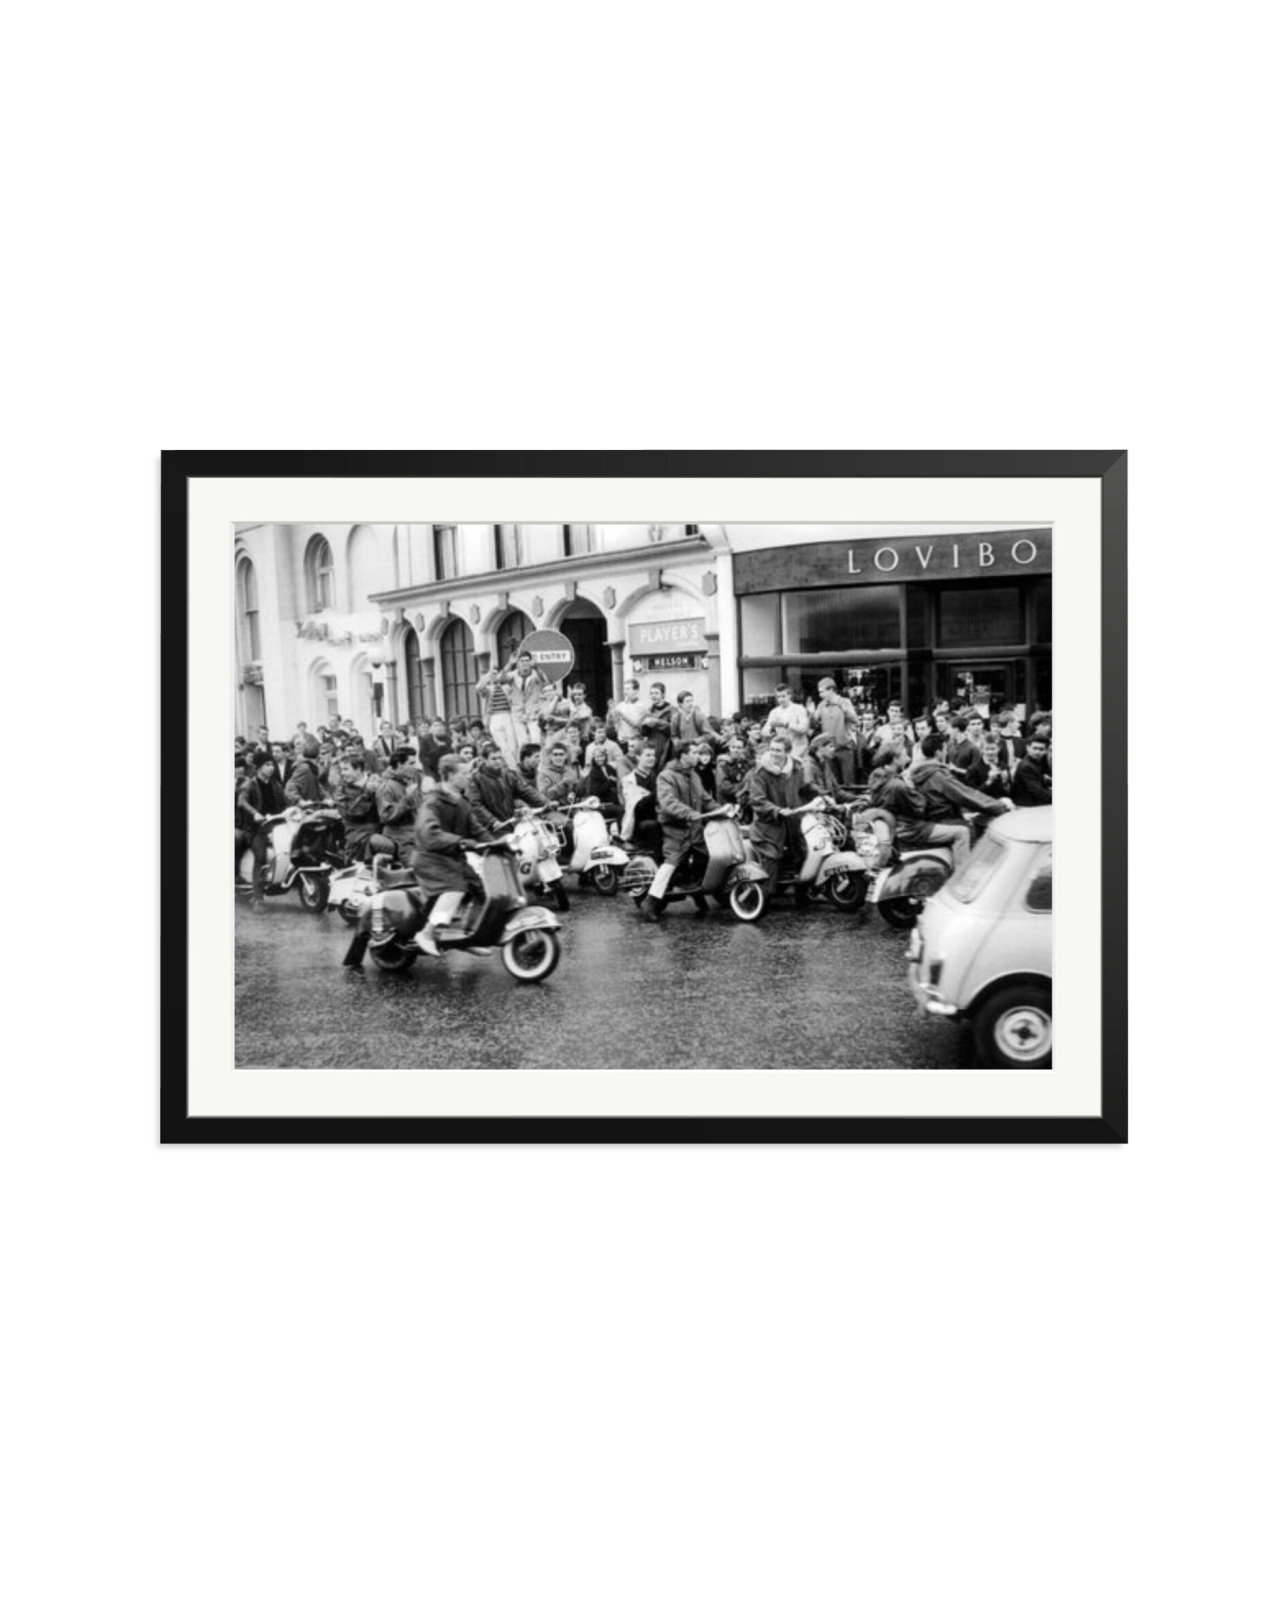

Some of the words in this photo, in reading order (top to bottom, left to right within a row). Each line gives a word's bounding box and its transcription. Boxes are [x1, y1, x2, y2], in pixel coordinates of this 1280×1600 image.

[848, 539, 1037, 573] LOVIBO
[540, 652, 567, 661] ENTRY
[654, 657, 688, 668] NELSON
[520, 862, 531, 874] G
